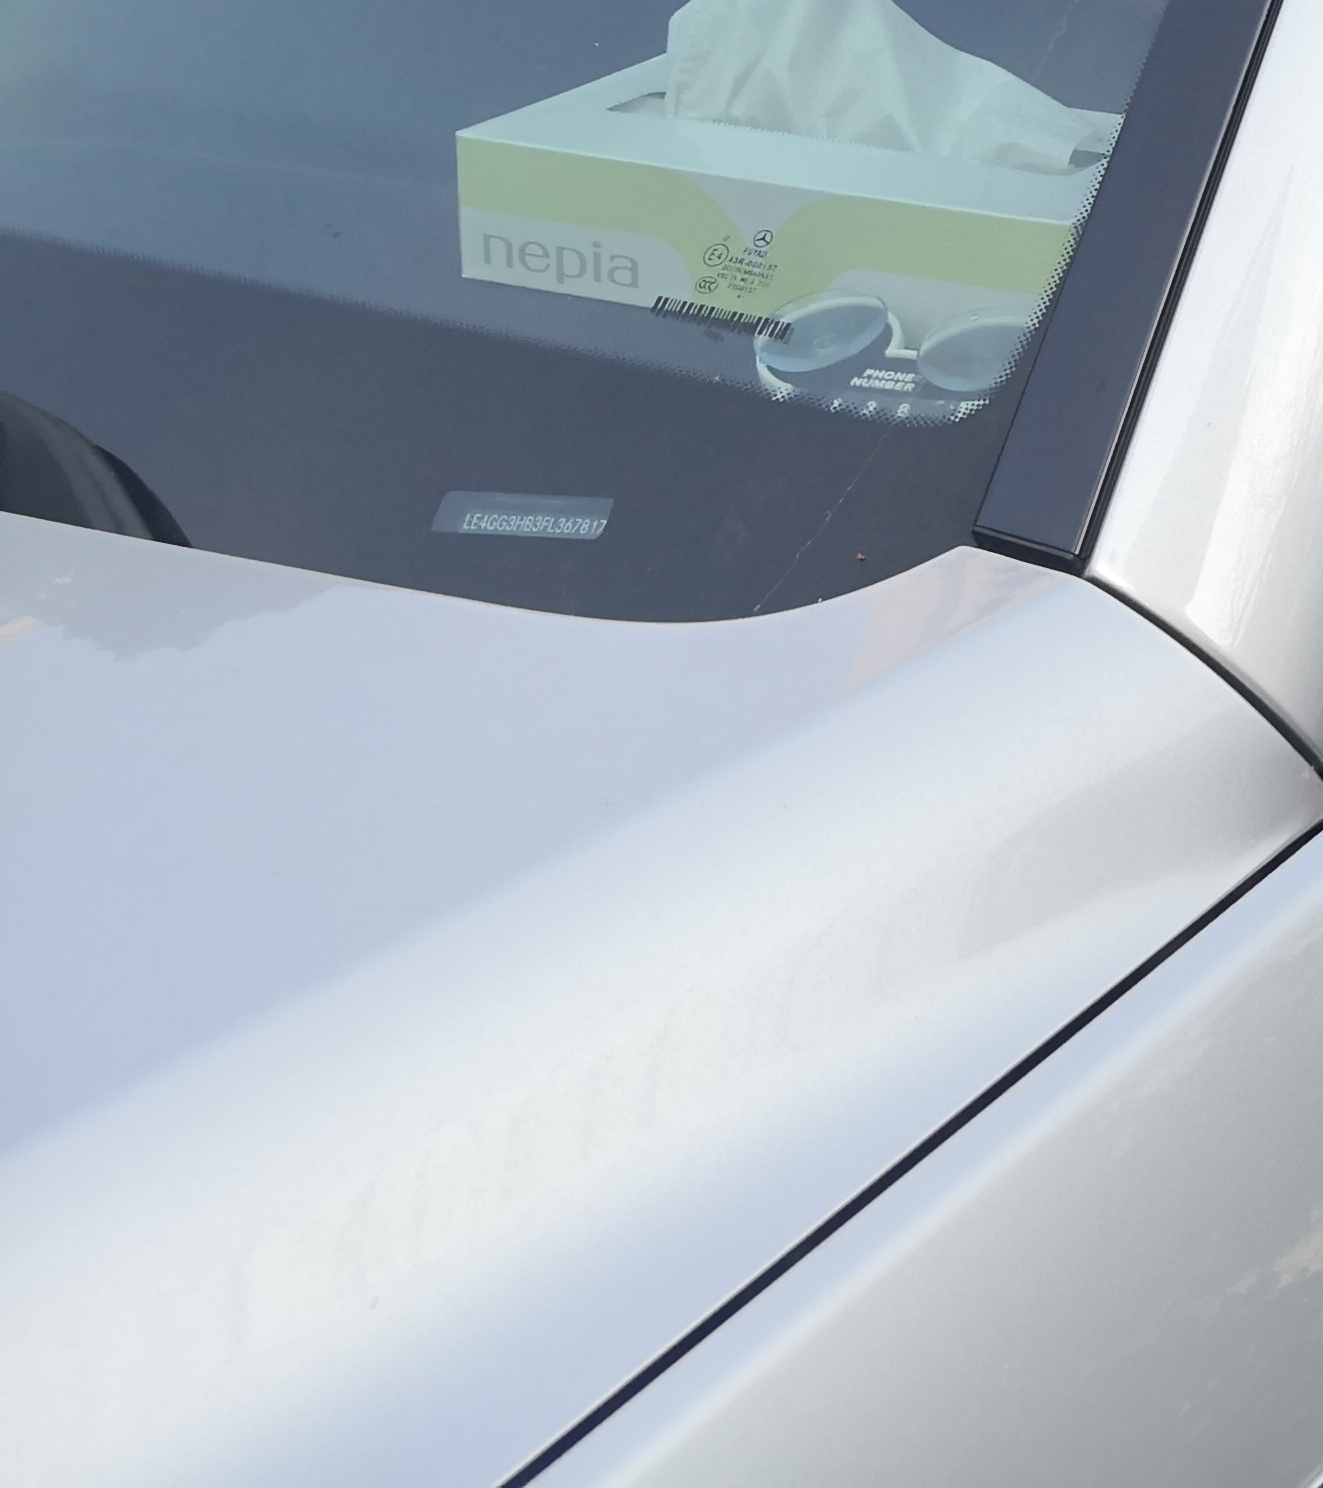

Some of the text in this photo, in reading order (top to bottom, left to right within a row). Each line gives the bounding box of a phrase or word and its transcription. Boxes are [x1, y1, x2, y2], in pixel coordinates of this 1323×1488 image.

[483, 233, 639, 288] nepia
[863, 368, 915, 382] PHONE
[850, 377, 916, 392] NUMBER
[463, 513, 607, 534] LE4GG3HB3FL367817
